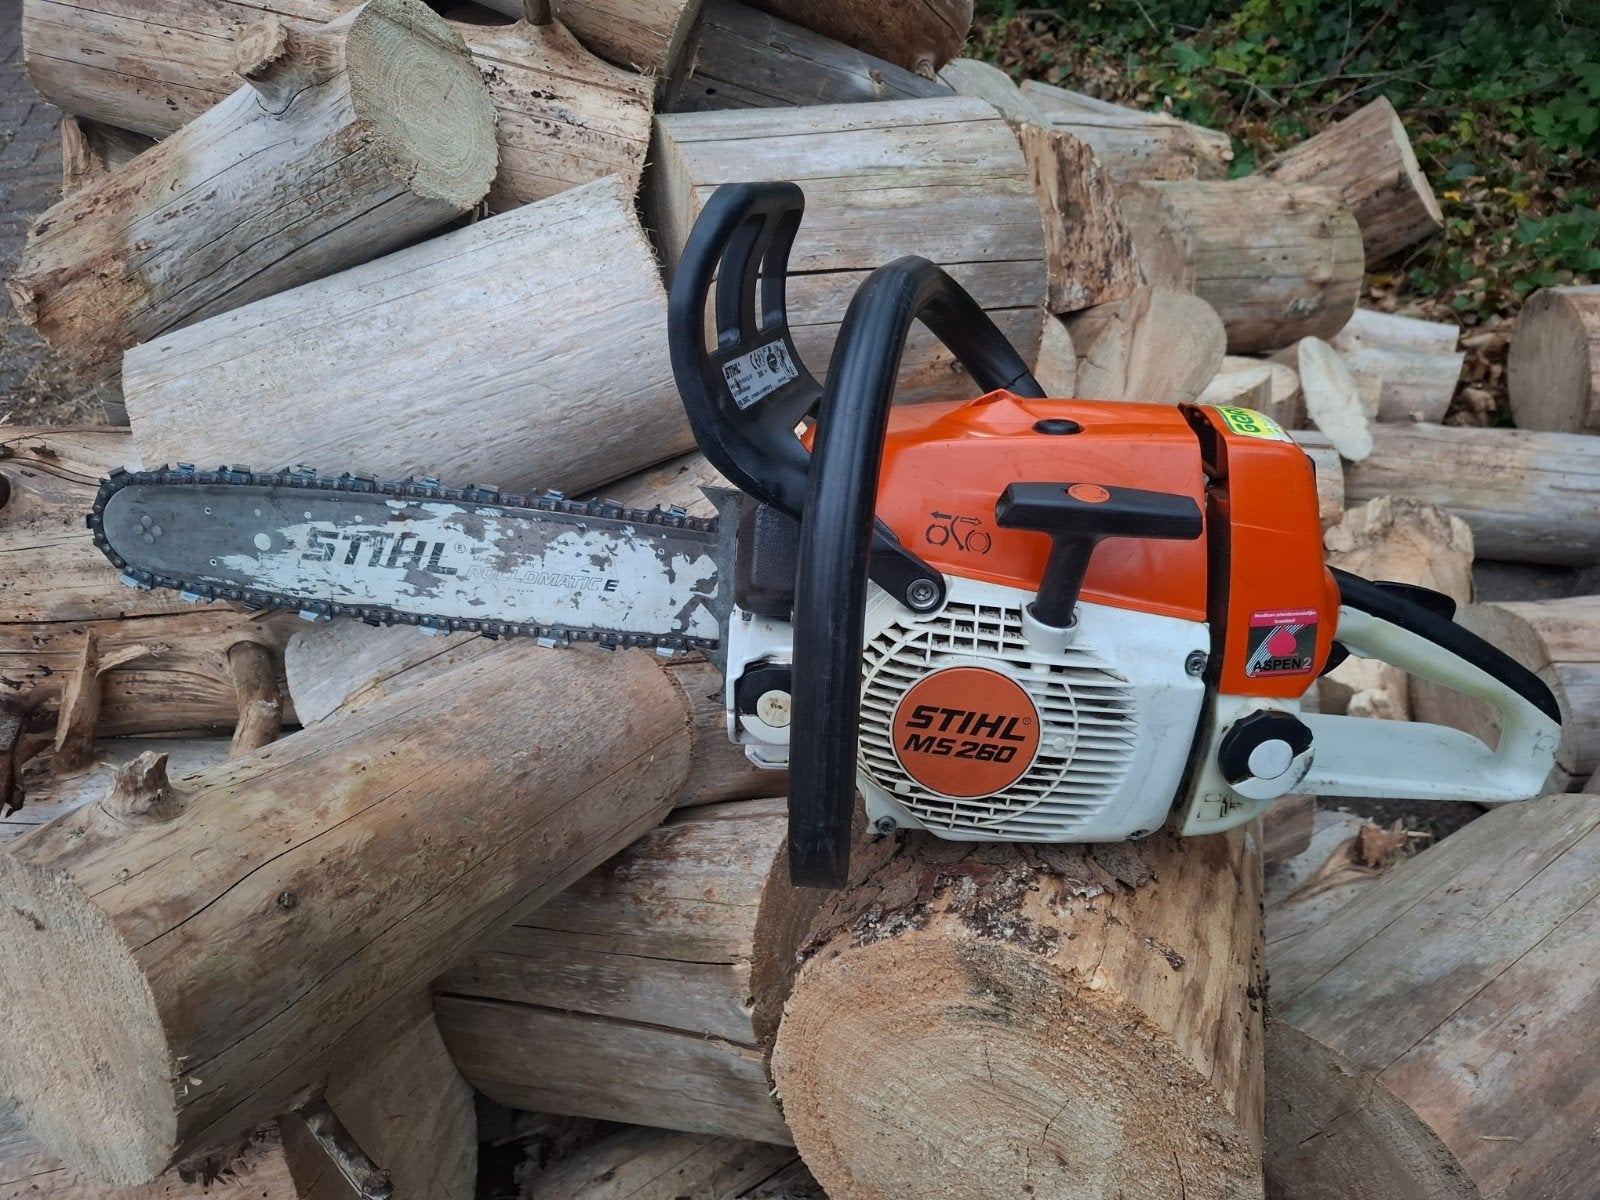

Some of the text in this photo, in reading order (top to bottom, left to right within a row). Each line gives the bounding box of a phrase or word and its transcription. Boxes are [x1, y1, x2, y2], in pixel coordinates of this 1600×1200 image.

[301, 527, 459, 576] STIHL
[467, 565, 620, 592] ROLLOMATIC E
[1253, 656, 1312, 671] ASPEN 2
[905, 705, 1026, 742] STIHL
[903, 733, 1018, 763] MS 260
